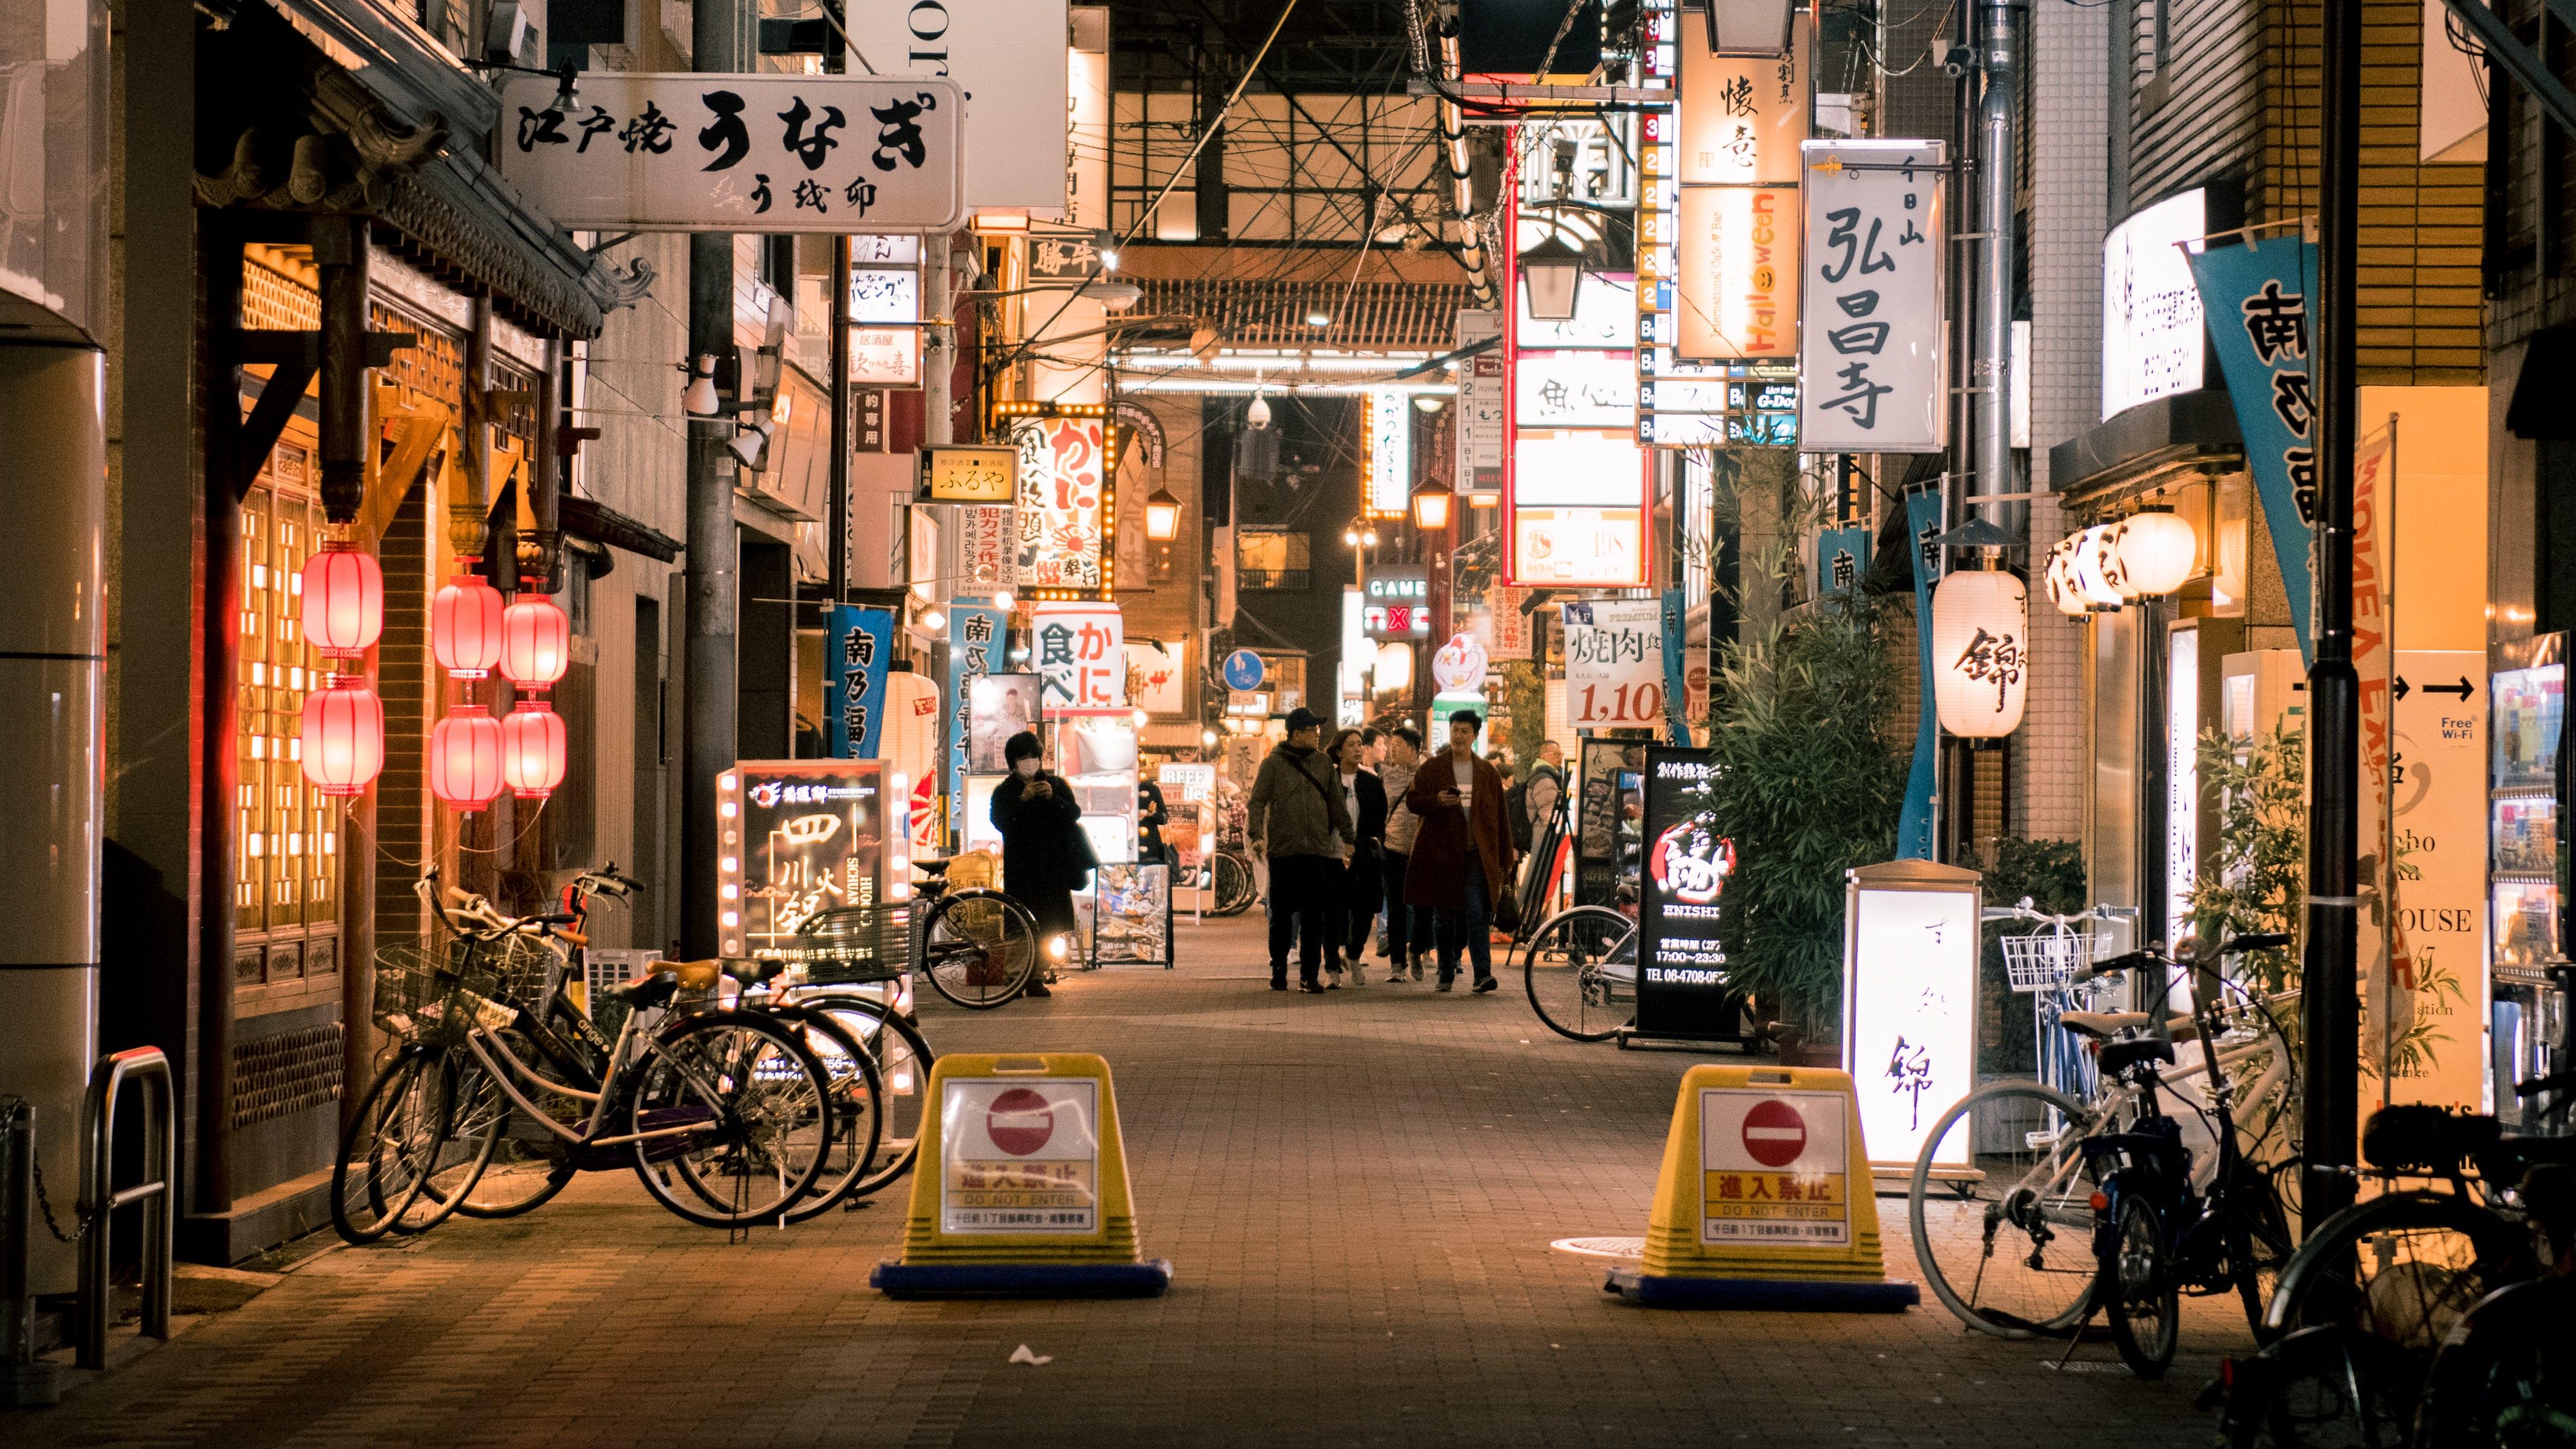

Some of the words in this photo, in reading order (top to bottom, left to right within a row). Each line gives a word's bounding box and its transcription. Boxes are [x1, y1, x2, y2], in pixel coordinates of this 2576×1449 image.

[518, 100, 677, 154] 江戸焼
[698, 90, 938, 171] うなぎ
[1646, 119, 1658, 137] 3
[1646, 153, 1658, 169] 2
[1646, 187, 1657, 203] 2
[1644, 221, 1656, 236] 2
[1644, 253, 1656, 270] 2
[1644, 288, 1656, 304] 2
[1819, 207, 1896, 430] 弘昌寺
[860, 335, 894, 346] 居酒屋
[1463, 360, 1473, 373] 3
[1463, 382, 1473, 395] 2
[940, 470, 1004, 491] ふるや
[1370, 579, 1427, 597] GAME
[1078, 621, 1112, 703] かに
[2441, 717, 2473, 728] Free
[2442, 729, 2473, 740] Wi-Fi
[847, 857, 859, 904] SICHUAN
[1663, 905, 1720, 917] ENISHI
[2400, 908, 2472, 932] OUSE
[1646, 968, 1663, 982] TEL
[962, 1164, 1076, 1189] 進入禁止
[1720, 1175, 1831, 1201] 進入禁止
[965, 1195, 985, 1204] DO
[994, 1195, 1021, 1204] NOT
[1030, 1195, 1075, 1205] ENTER
[1723, 1206, 1742, 1215] DO
[1750, 1206, 1778, 1216] NOT
[1786, 1206, 1828, 1217] ENTER
